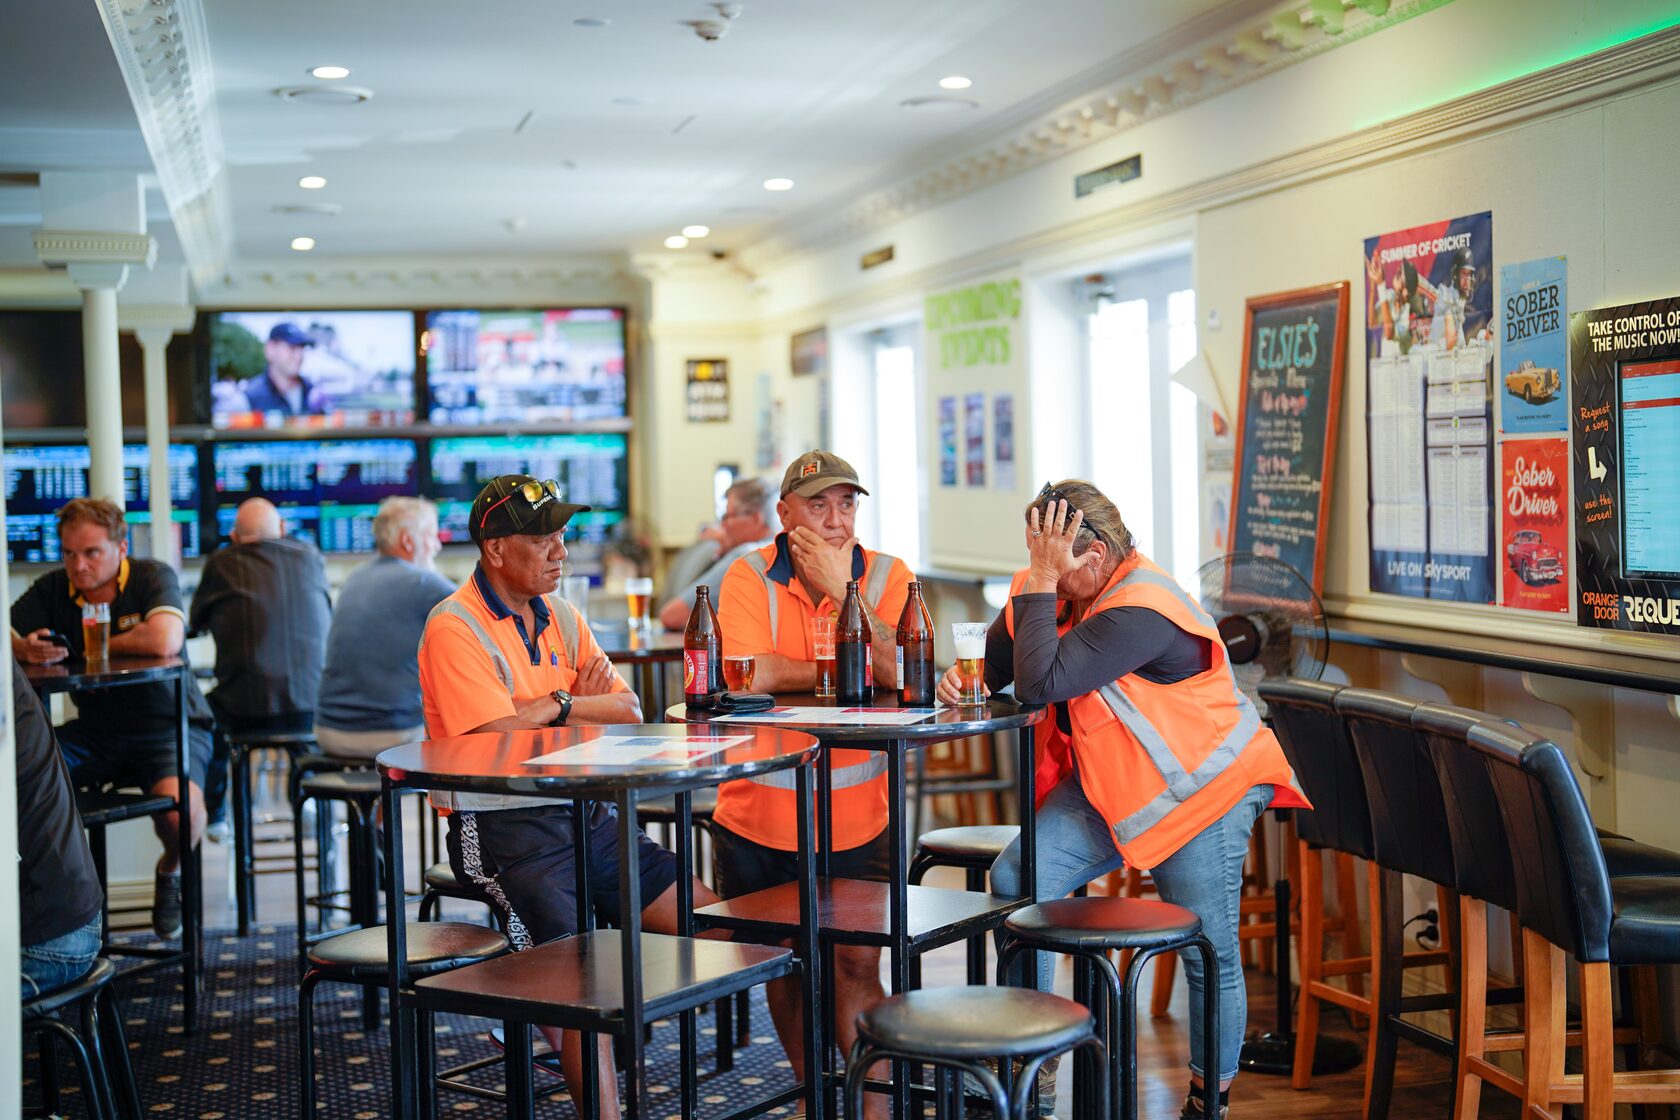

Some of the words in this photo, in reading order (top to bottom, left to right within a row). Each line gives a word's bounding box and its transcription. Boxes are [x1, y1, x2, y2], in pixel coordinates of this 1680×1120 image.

[1381, 244, 1417, 264] SUMMER
[1418, 241, 1431, 257] OF
[1432, 232, 1472, 254] CRICKET
[1506, 284, 1560, 321] SOBER
[1506, 309, 1560, 343] DRIVER
[1587, 319, 1613, 337] TAKE
[1614, 313, 1665, 334] CONTROL
[1667, 310, 1680, 327] OF
[1258, 316, 1320, 370] ELSIE'S
[1592, 336, 1612, 353] THE
[1614, 332, 1648, 350] MUSIC
[1649, 328, 1680, 346] NOW!
[1580, 401, 1611, 420] Request
[1585, 424, 1591, 433] a
[1592, 419, 1609, 432] song
[1513, 455, 1556, 487] Sober
[1507, 485, 1558, 516] Driver
[1584, 501, 1598, 510] use
[1600, 494, 1612, 506] the
[1586, 505, 1612, 523] screen!
[1387, 560, 1406, 576] LIVE
[1407, 561, 1422, 577] ON
[1582, 591, 1619, 607] ORANGE
[1593, 605, 1620, 620] DOOR
[1623, 595, 1680, 626] REQUE
